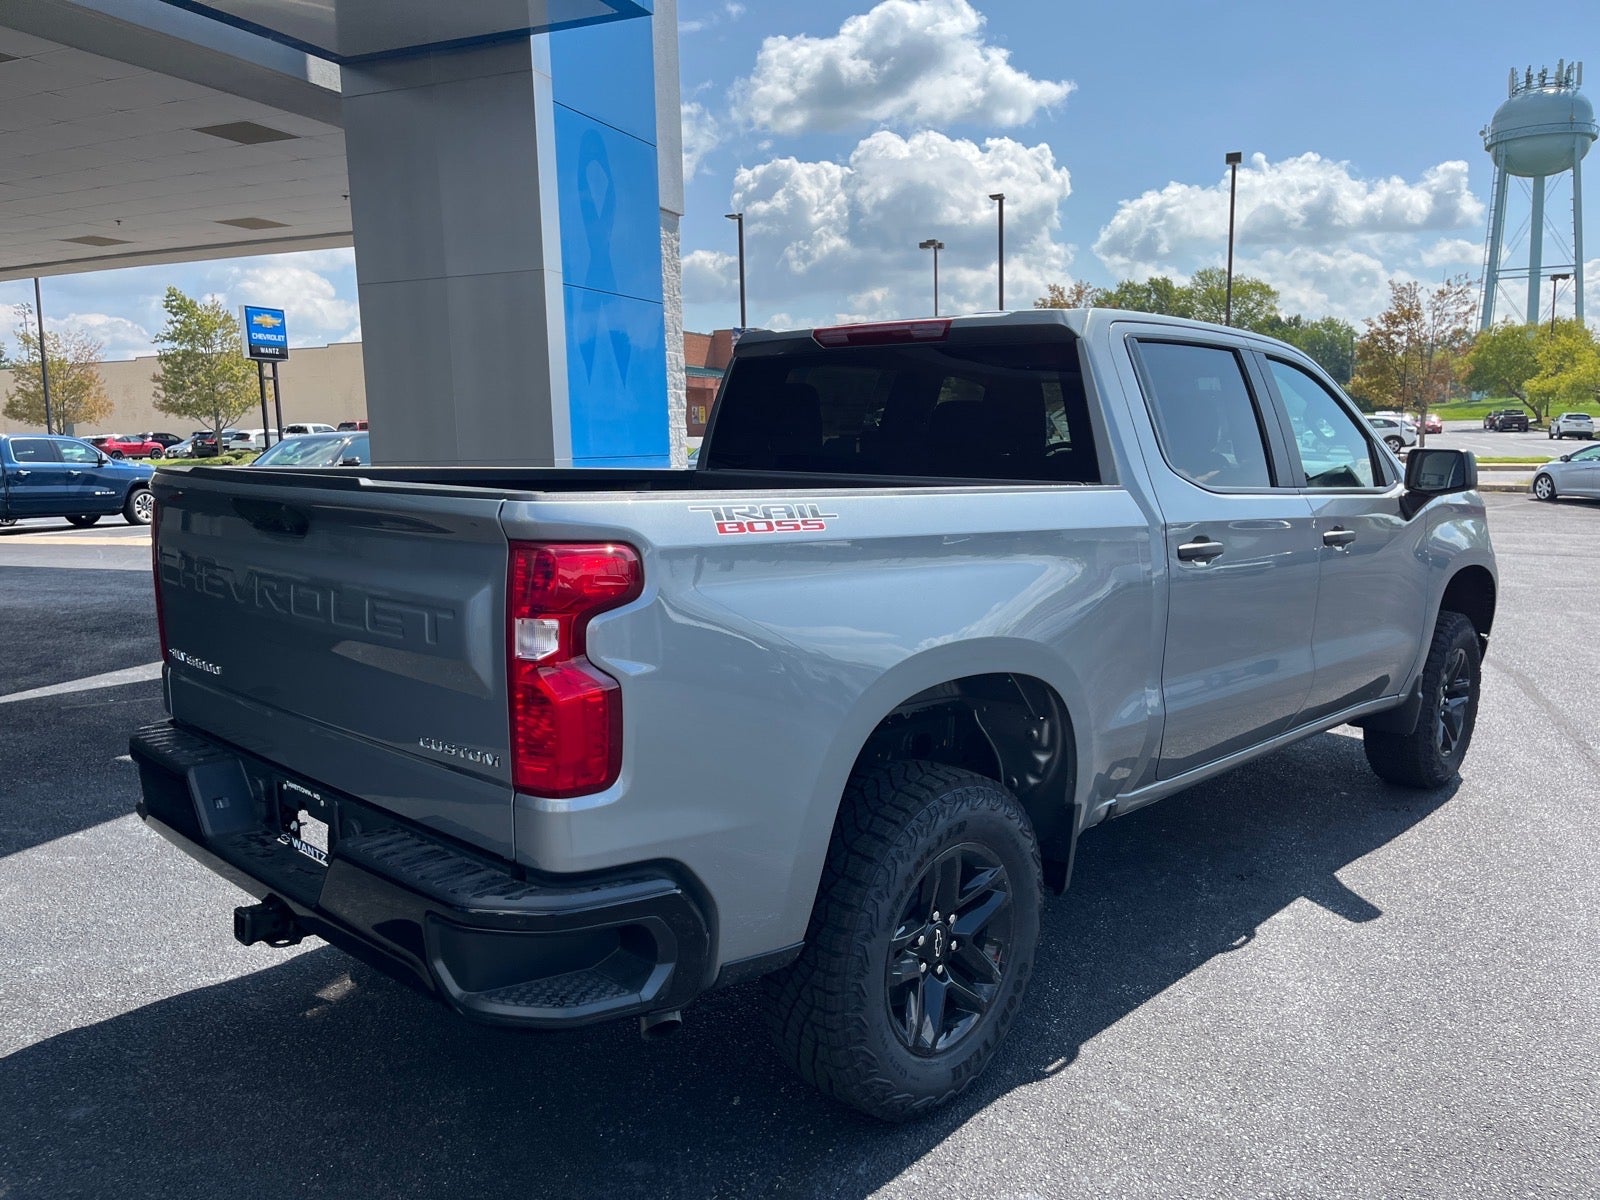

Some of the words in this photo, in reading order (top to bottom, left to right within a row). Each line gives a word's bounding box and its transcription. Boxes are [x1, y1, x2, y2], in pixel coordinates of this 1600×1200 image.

[251, 332, 286, 342] CHEVROLET
[259, 347, 280, 355] WANTZ
[688, 503, 839, 521] TRAIL
[715, 518, 827, 536] BOSS
[158, 545, 456, 646] CHEVROLET
[419, 737, 501, 768] CUSTOM
[291, 837, 328, 864] WANTZ
